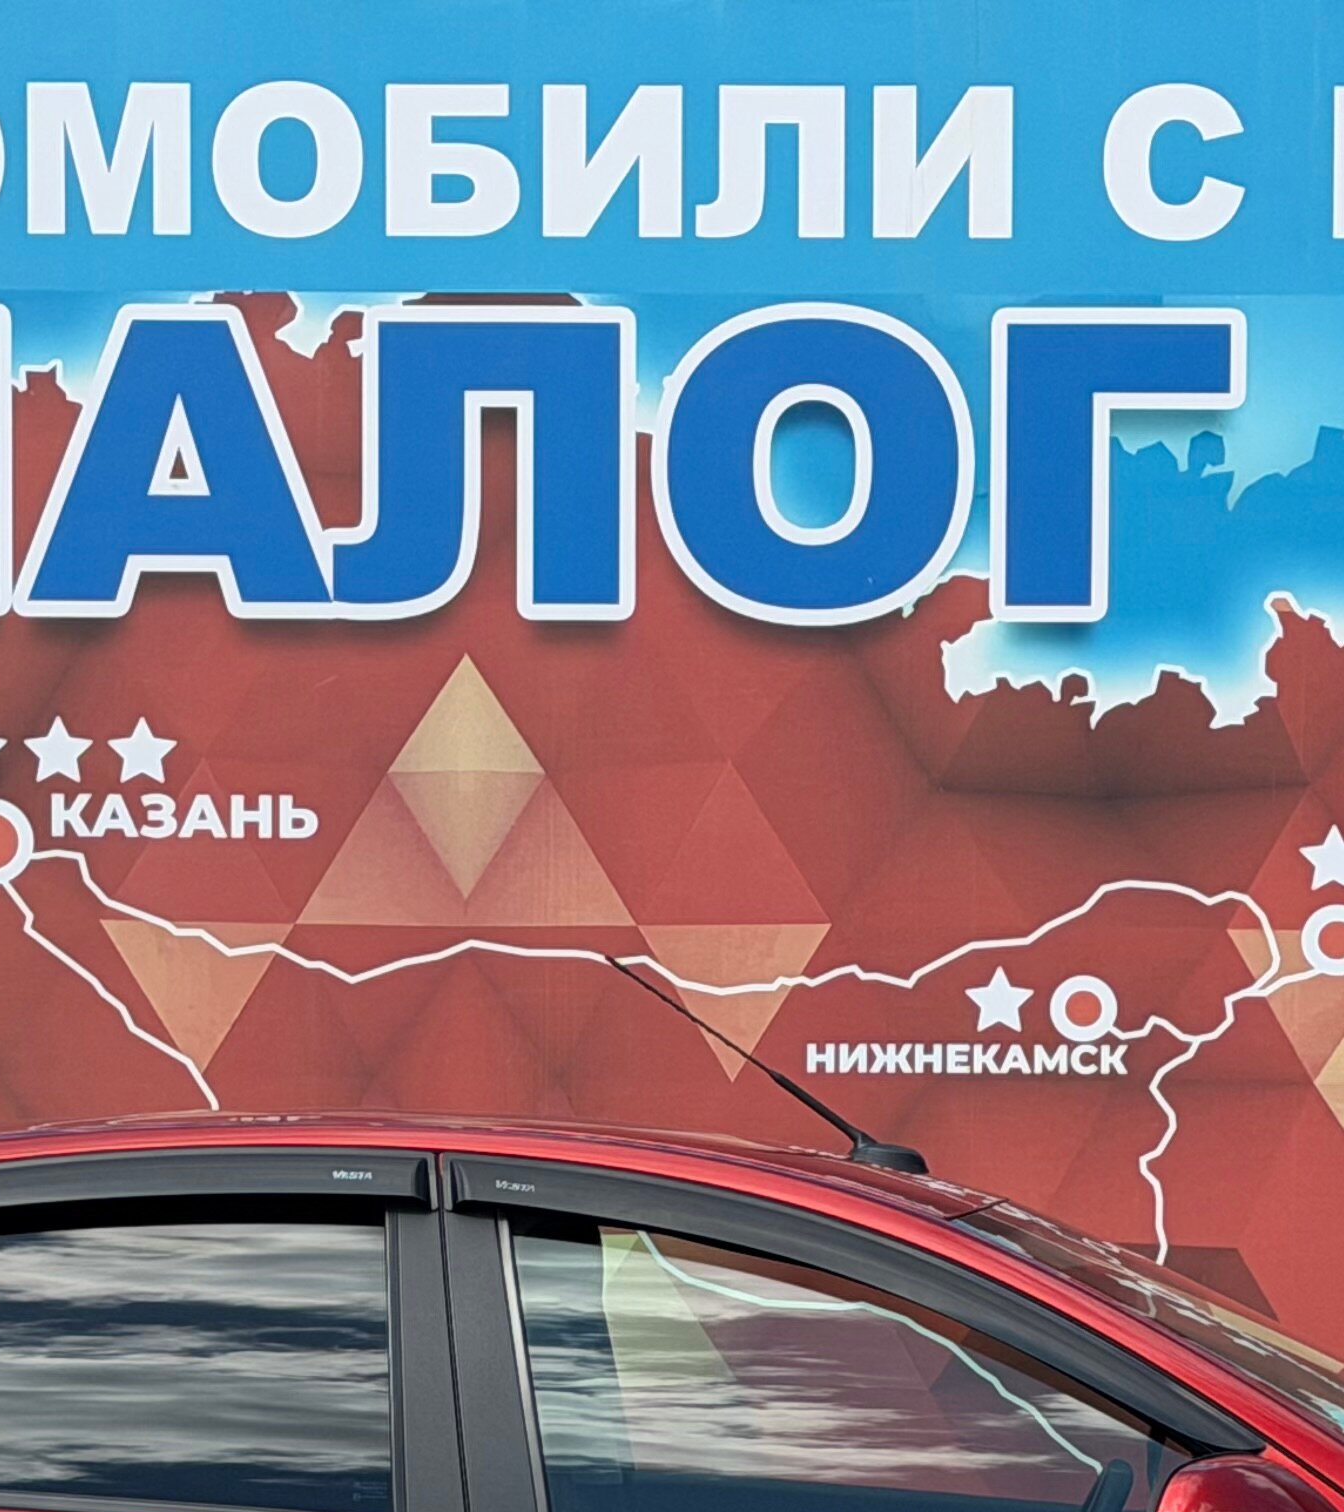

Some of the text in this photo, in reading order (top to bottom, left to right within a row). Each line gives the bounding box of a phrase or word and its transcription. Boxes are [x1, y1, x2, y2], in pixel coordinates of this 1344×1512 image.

[1103, 83, 1246, 240] С
[51, 793, 319, 839] КАЗАНЬ
[806, 1043, 1128, 1075] НИЖНЕКАМСК
